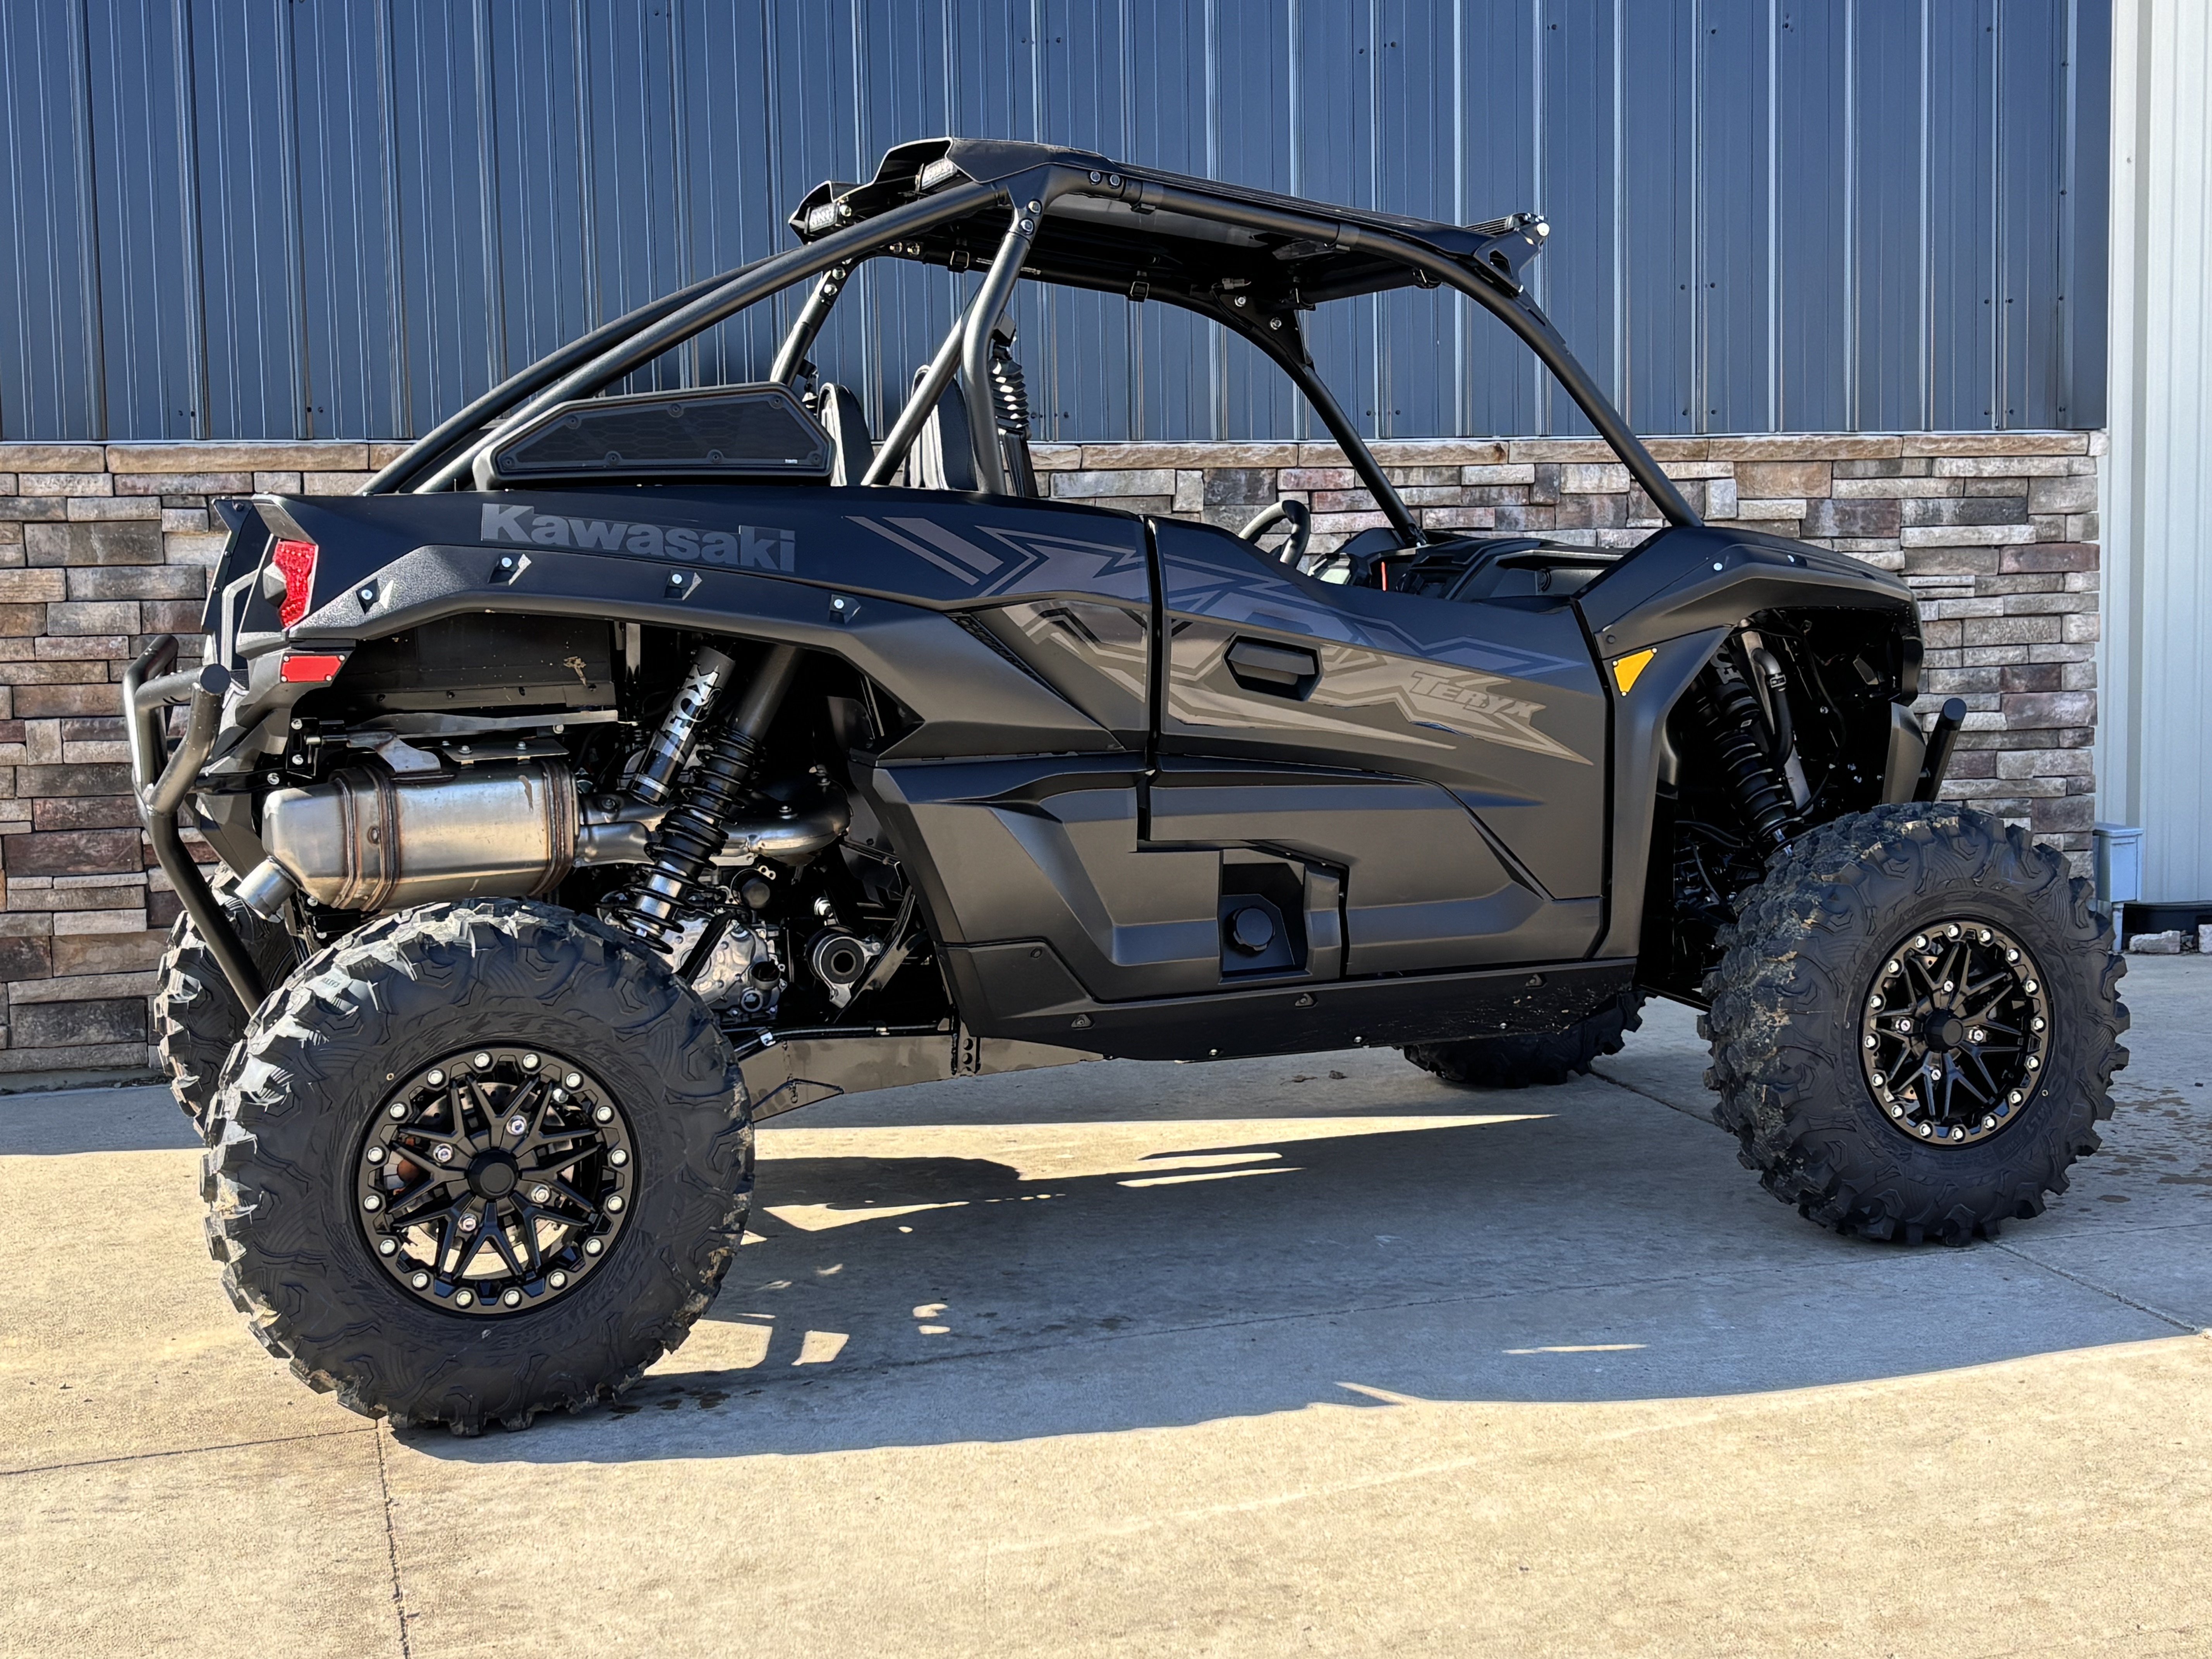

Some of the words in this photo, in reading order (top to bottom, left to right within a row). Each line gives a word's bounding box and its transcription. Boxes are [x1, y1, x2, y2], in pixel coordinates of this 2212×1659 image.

[481, 503, 795, 572] Kawasaki
[660, 664, 721, 741] FOX
[1410, 671, 1546, 718] TERYX
